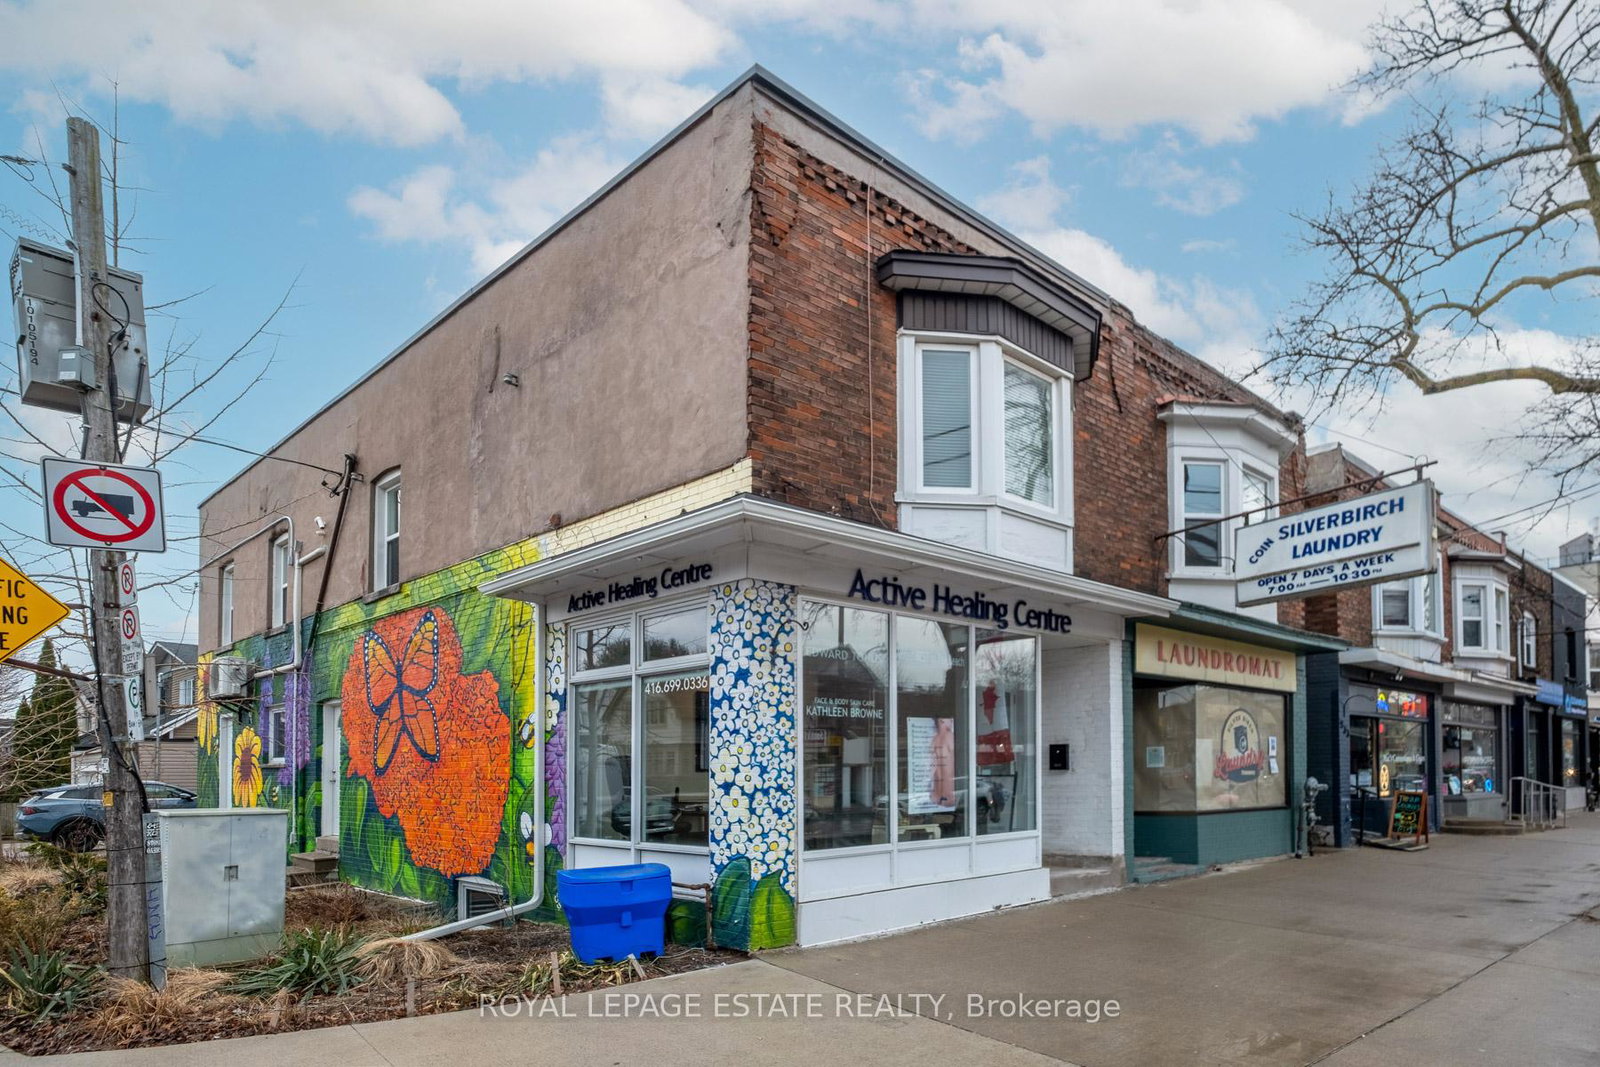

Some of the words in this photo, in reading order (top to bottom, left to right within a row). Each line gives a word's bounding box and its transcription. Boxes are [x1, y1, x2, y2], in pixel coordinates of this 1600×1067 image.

[26, 299, 39, 366] 10105194
[1279, 497, 1405, 541] SILVERBIRCH
[1249, 537, 1275, 565] COIN
[1292, 526, 1384, 559] LAUNDRY
[1257, 574, 1287, 587] OPEN
[1291, 572, 1298, 581] 7
[1303, 565, 1334, 578] DAYS
[1341, 562, 1350, 571] A
[1354, 553, 1395, 569] WEEK
[567, 590, 606, 613] Active
[608, 576, 658, 603] Healing
[660, 563, 713, 589] Centre
[848, 568, 926, 610] Active
[933, 583, 1008, 630] Healing
[1013, 600, 1073, 634] Centre
[1157, 639, 1281, 679] LAUNDROMAT
[644, 675, 708, 695] 416.699.0336
[814, 696, 828, 704] FACE
[806, 705, 848, 717] KATHLEEN
[850, 707, 883, 719] BROWNE
[1213, 748, 1264, 780] Laundry
